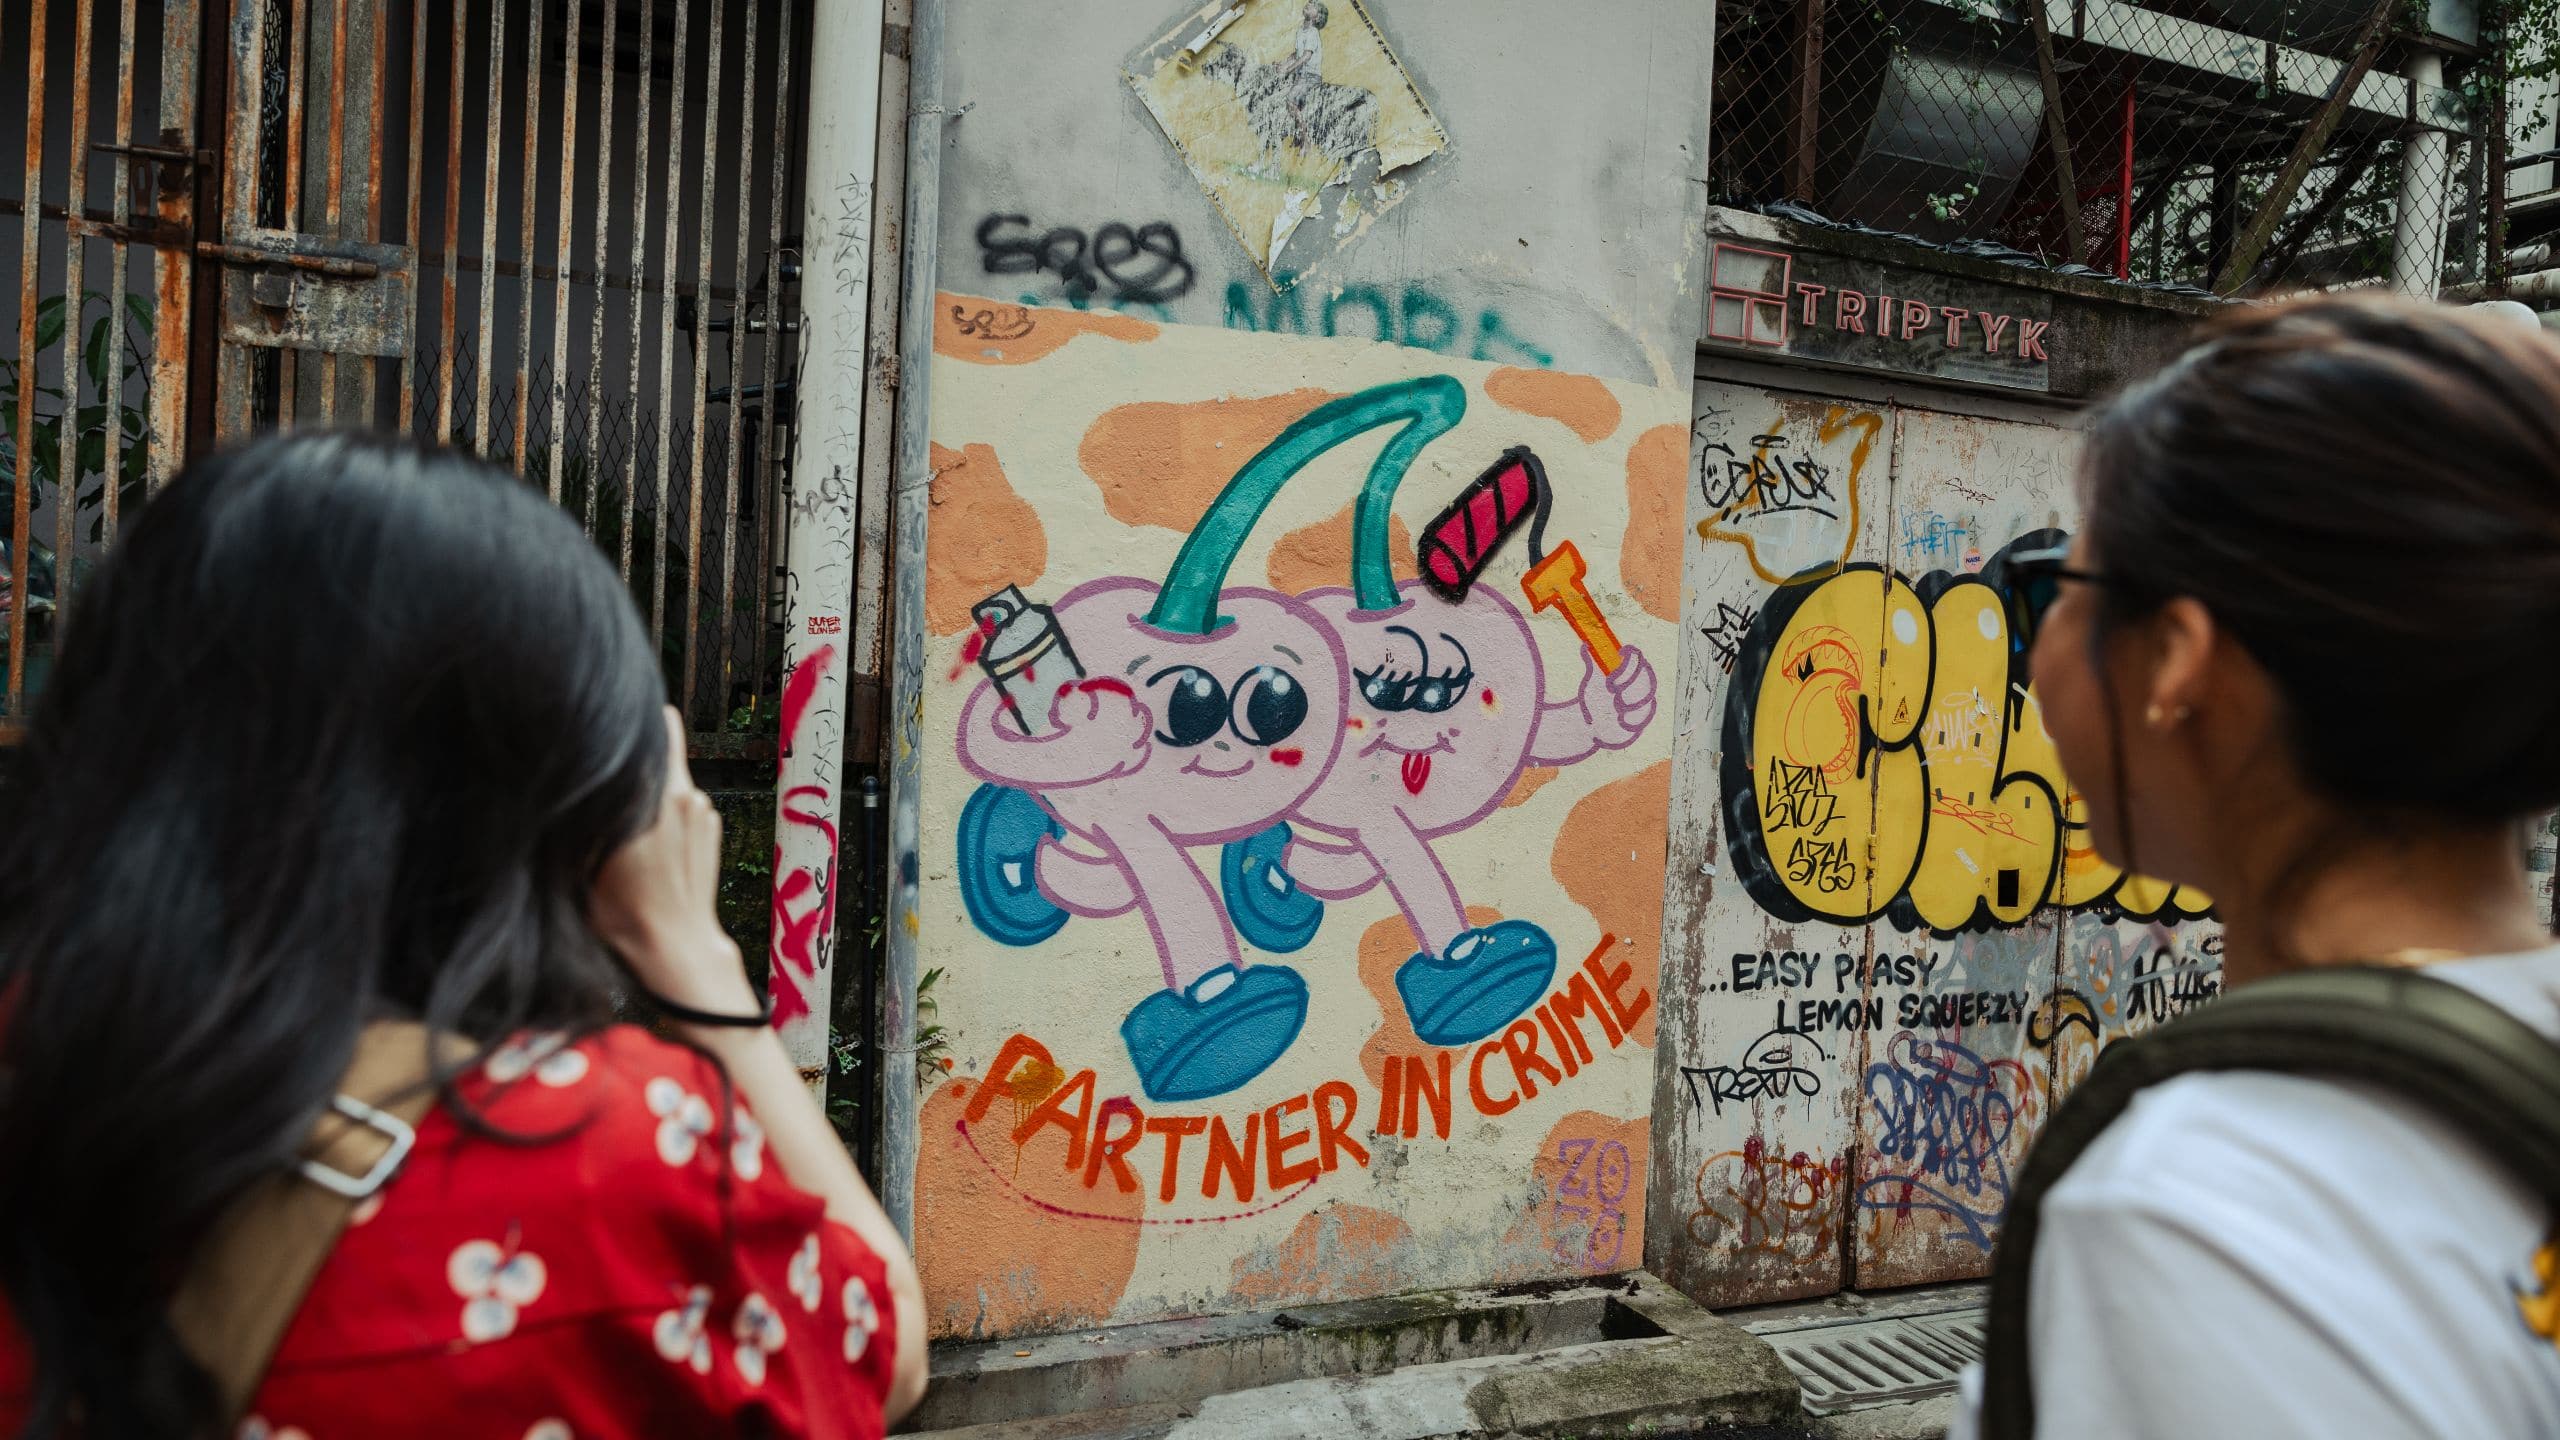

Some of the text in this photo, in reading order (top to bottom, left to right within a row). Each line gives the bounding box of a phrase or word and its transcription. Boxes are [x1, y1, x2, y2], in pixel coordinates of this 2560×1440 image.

[1796, 282, 2049, 361] TRIPTYK
[808, 616, 841, 627] SUPER
[1835, 952, 1939, 994] PEASY
[1777, 990, 2029, 1033] LEMON SQUEEZY
[964, 933, 1652, 1202] PARTNER IN CRIME
